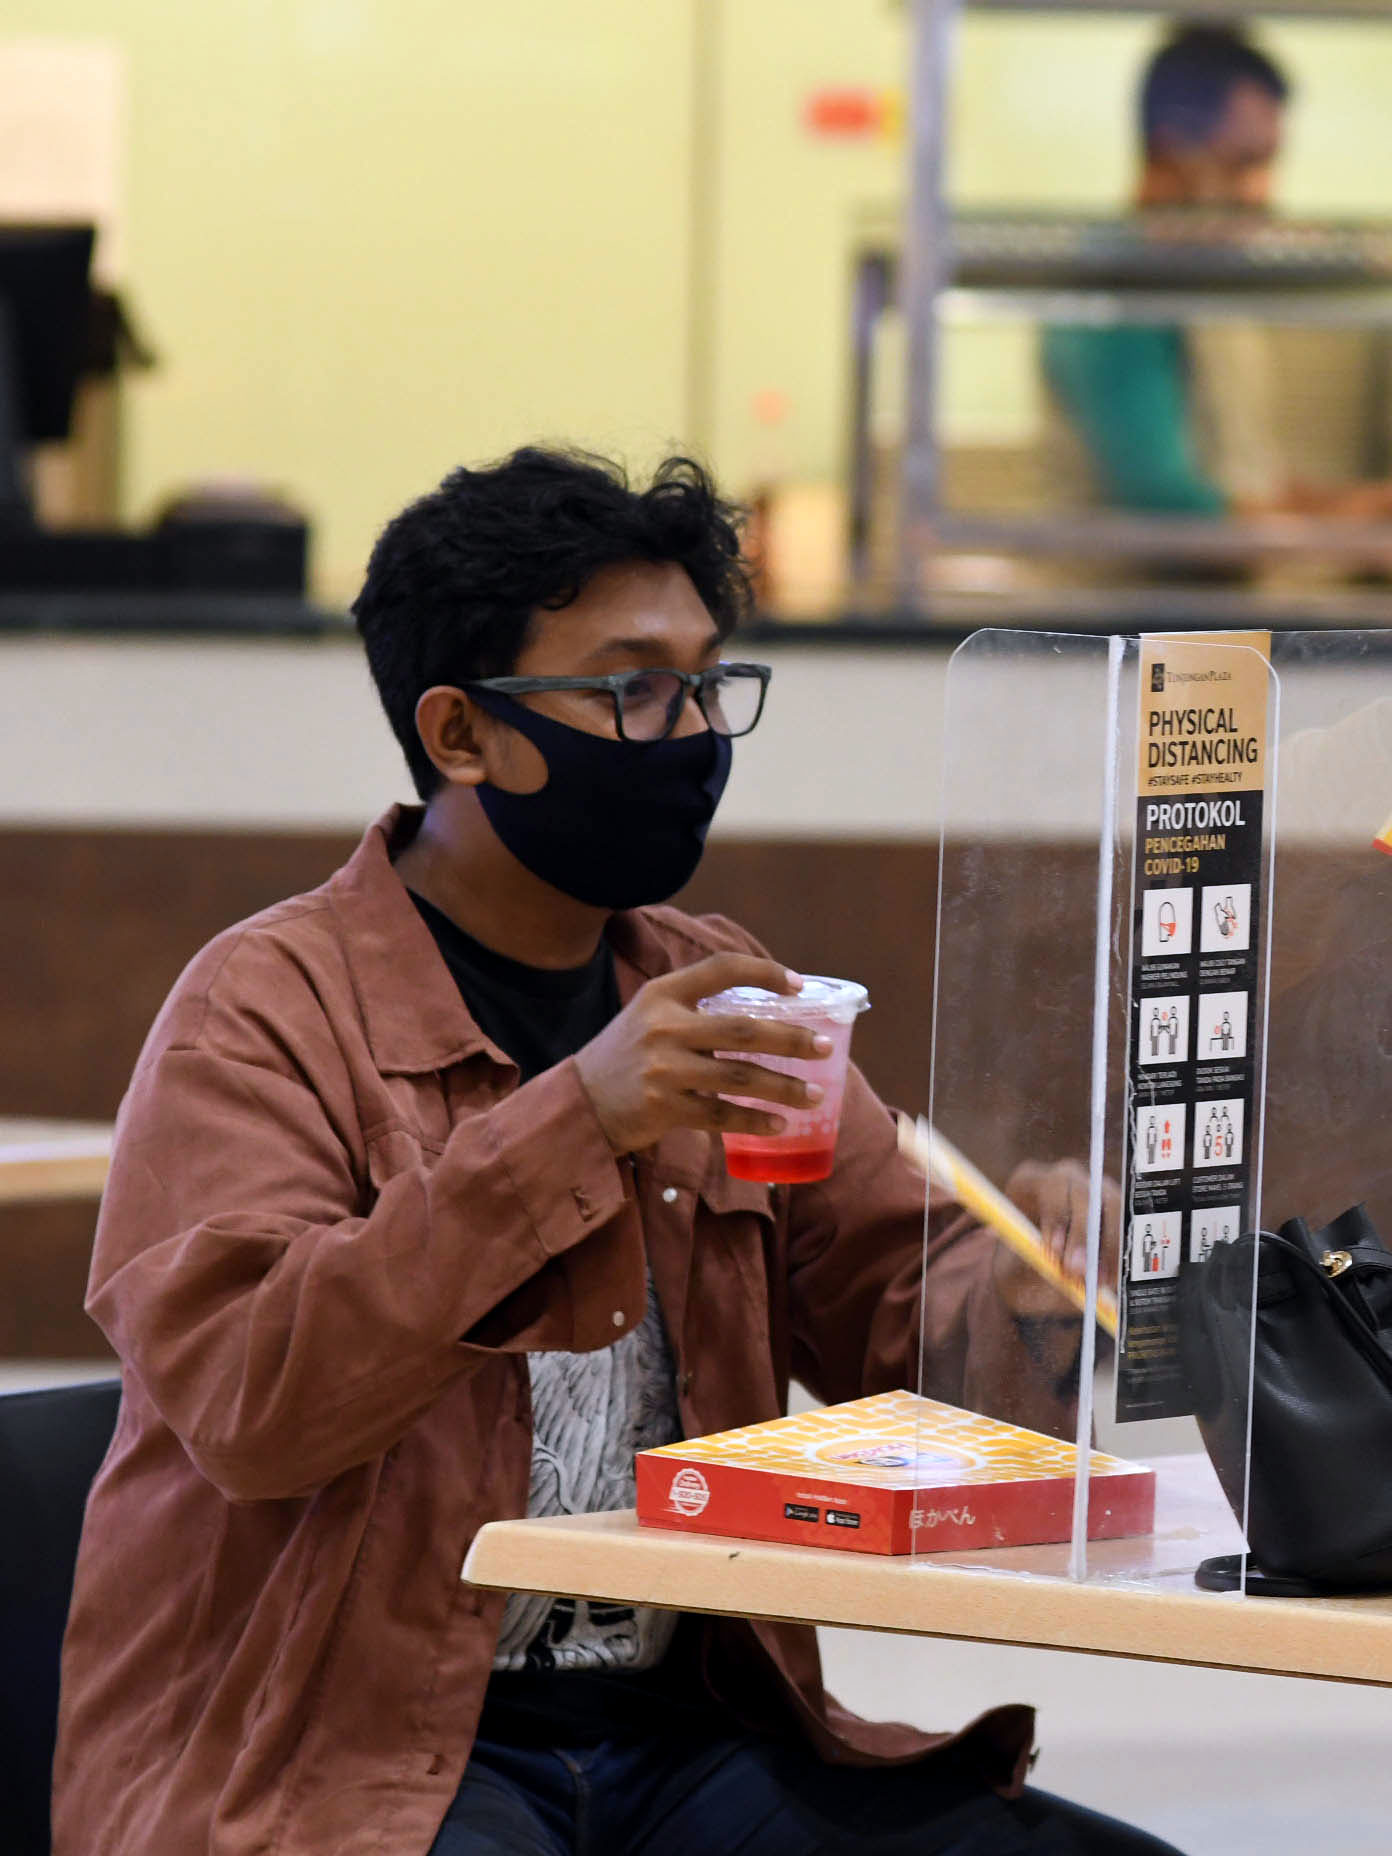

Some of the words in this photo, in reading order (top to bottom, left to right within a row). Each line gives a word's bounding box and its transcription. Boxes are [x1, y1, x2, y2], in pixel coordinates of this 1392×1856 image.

[1149, 707, 1238, 737] PHYSICAL
[1147, 737, 1258, 768] DISTANCING
[1147, 774, 1189, 787] #STAYSAFE
[1146, 800, 1246, 831] PROTOKOL
[1144, 833, 1226, 854] PENCEGAHAN
[1144, 857, 1200, 876] COVID-19
